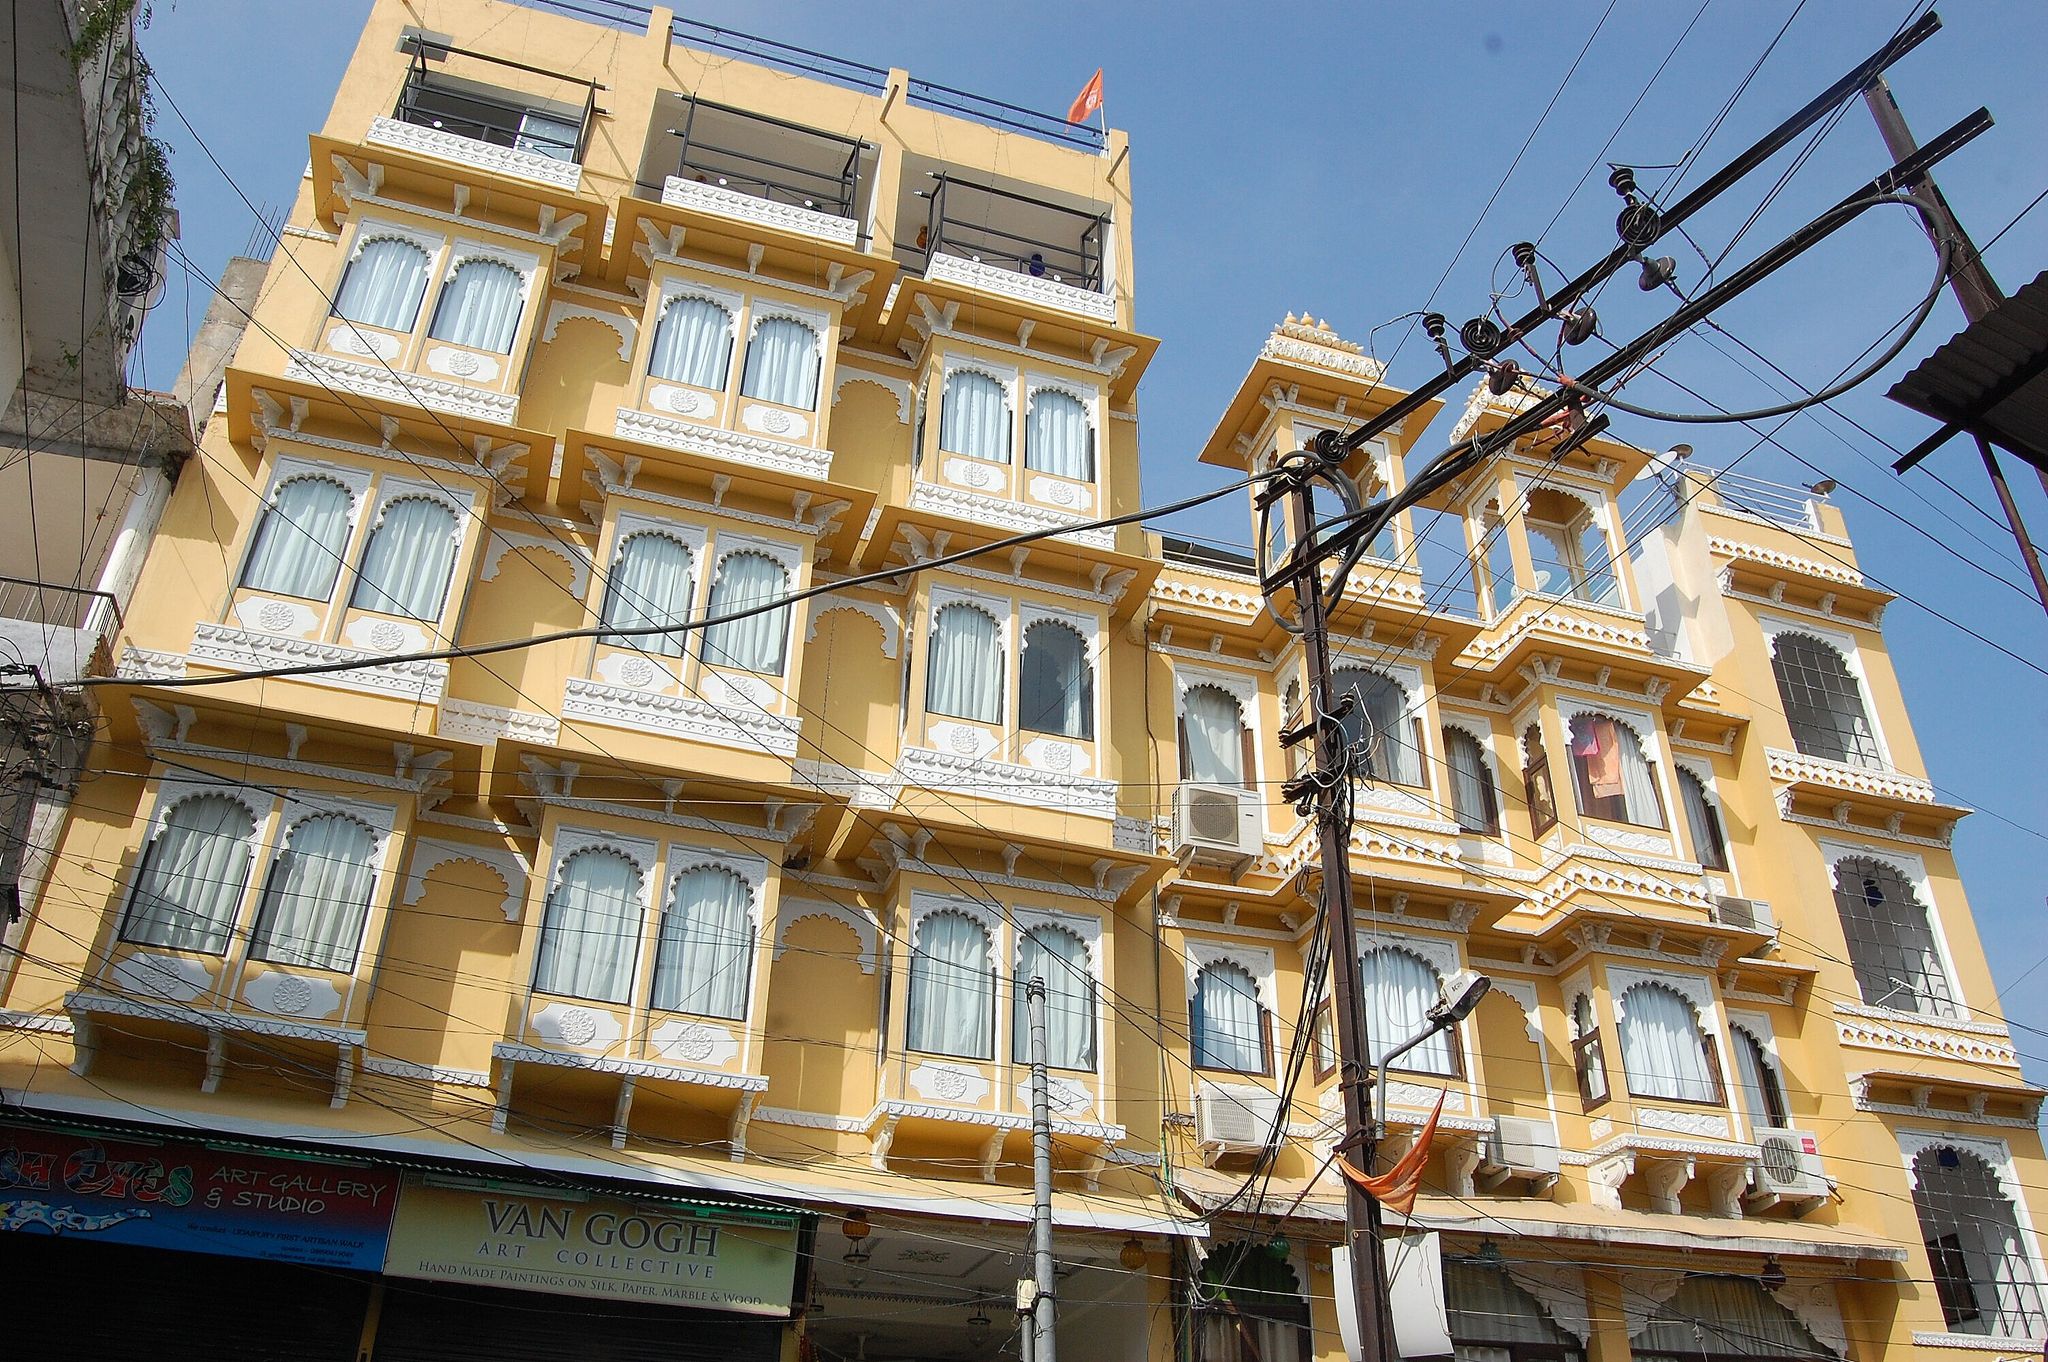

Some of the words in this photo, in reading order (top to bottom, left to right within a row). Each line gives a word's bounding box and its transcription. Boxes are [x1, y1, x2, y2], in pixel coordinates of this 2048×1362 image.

[204, 1188, 223, 1209] &
[232, 1191, 326, 1215] STUDIO
[209, 1166, 268, 1186] ART
[269, 1173, 387, 1207] GALLERY
[484, 1200, 574, 1241] VAN
[584, 1212, 720, 1258] GOGH
[478, 1242, 526, 1259] ART
[557, 1250, 714, 1279] COLLECTIVE
[419, 1261, 457, 1274] HAND
[460, 1266, 496, 1279] MADE
[500, 1270, 564, 1287] PAINTINGS
[661, 1287, 707, 1301] MARBLE
[710, 1292, 720, 1302] &
[723, 1293, 762, 1305] WOOD
